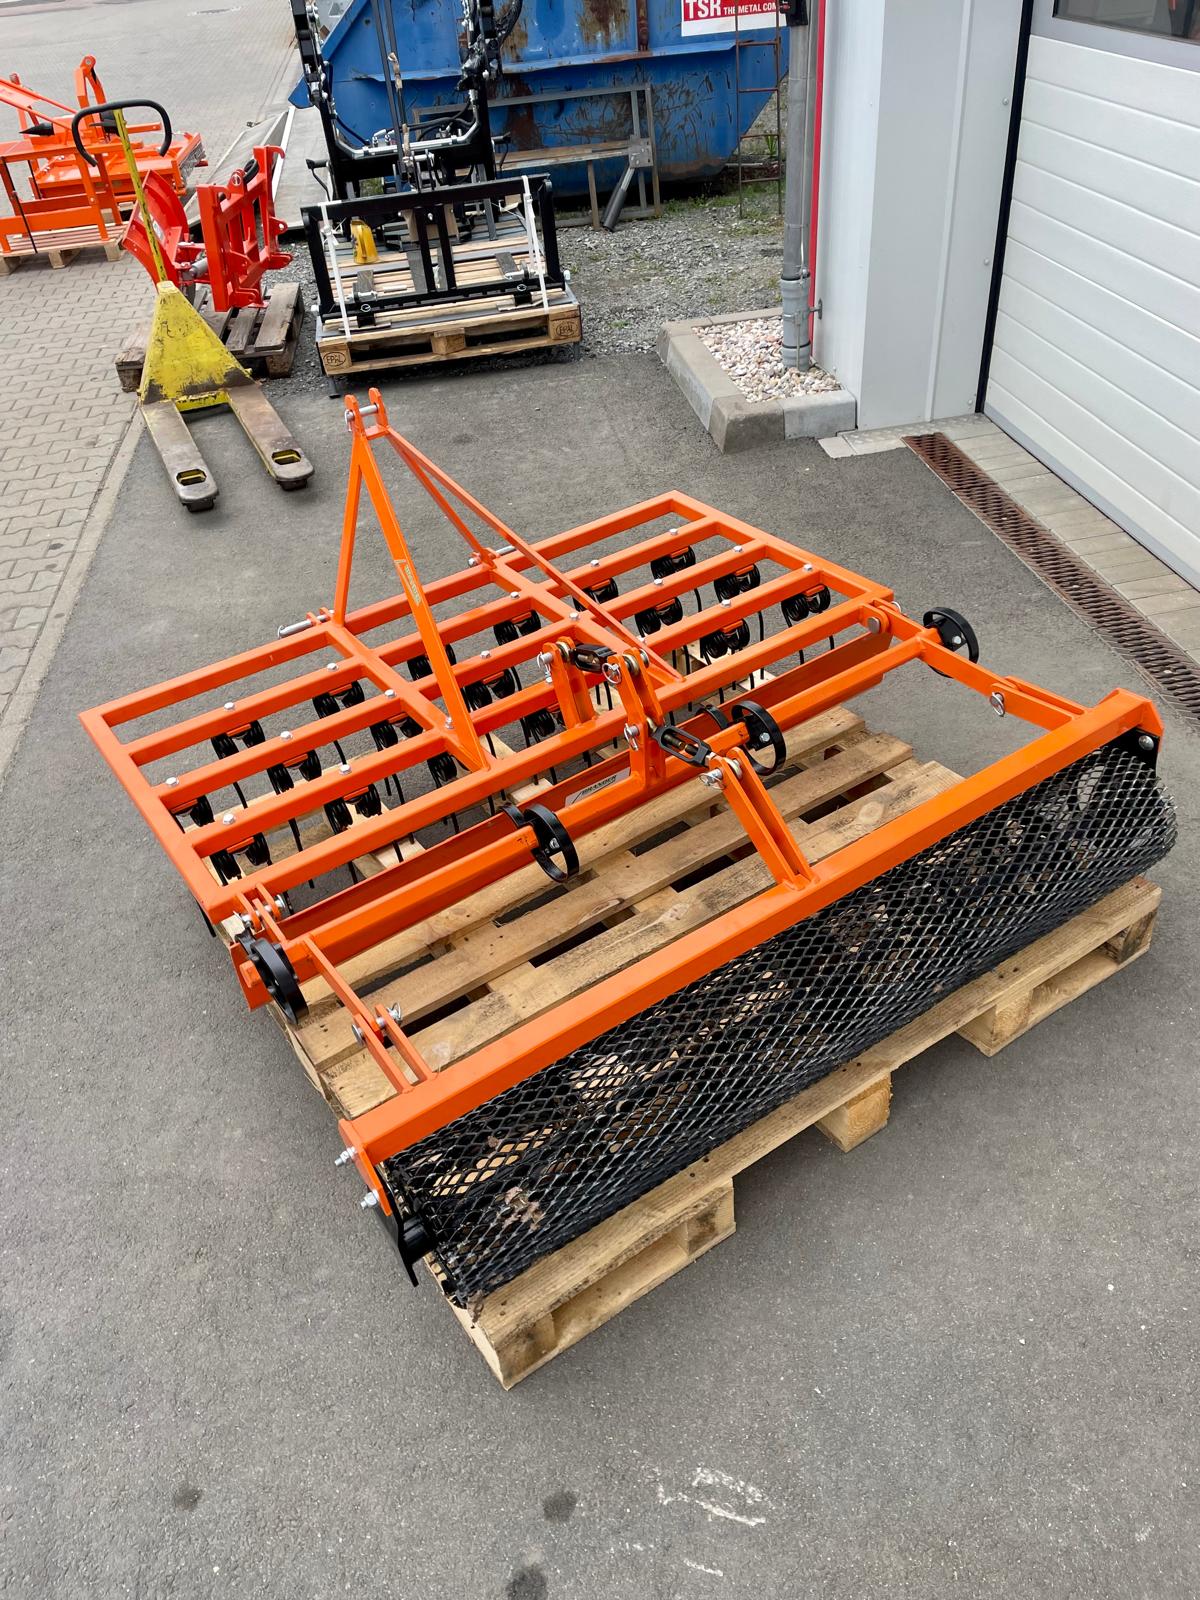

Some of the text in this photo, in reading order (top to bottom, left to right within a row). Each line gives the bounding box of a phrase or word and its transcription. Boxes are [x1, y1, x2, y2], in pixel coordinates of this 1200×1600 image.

[686, 0, 722, 19] TSR
[723, 2, 777, 15] THE METAL COM
